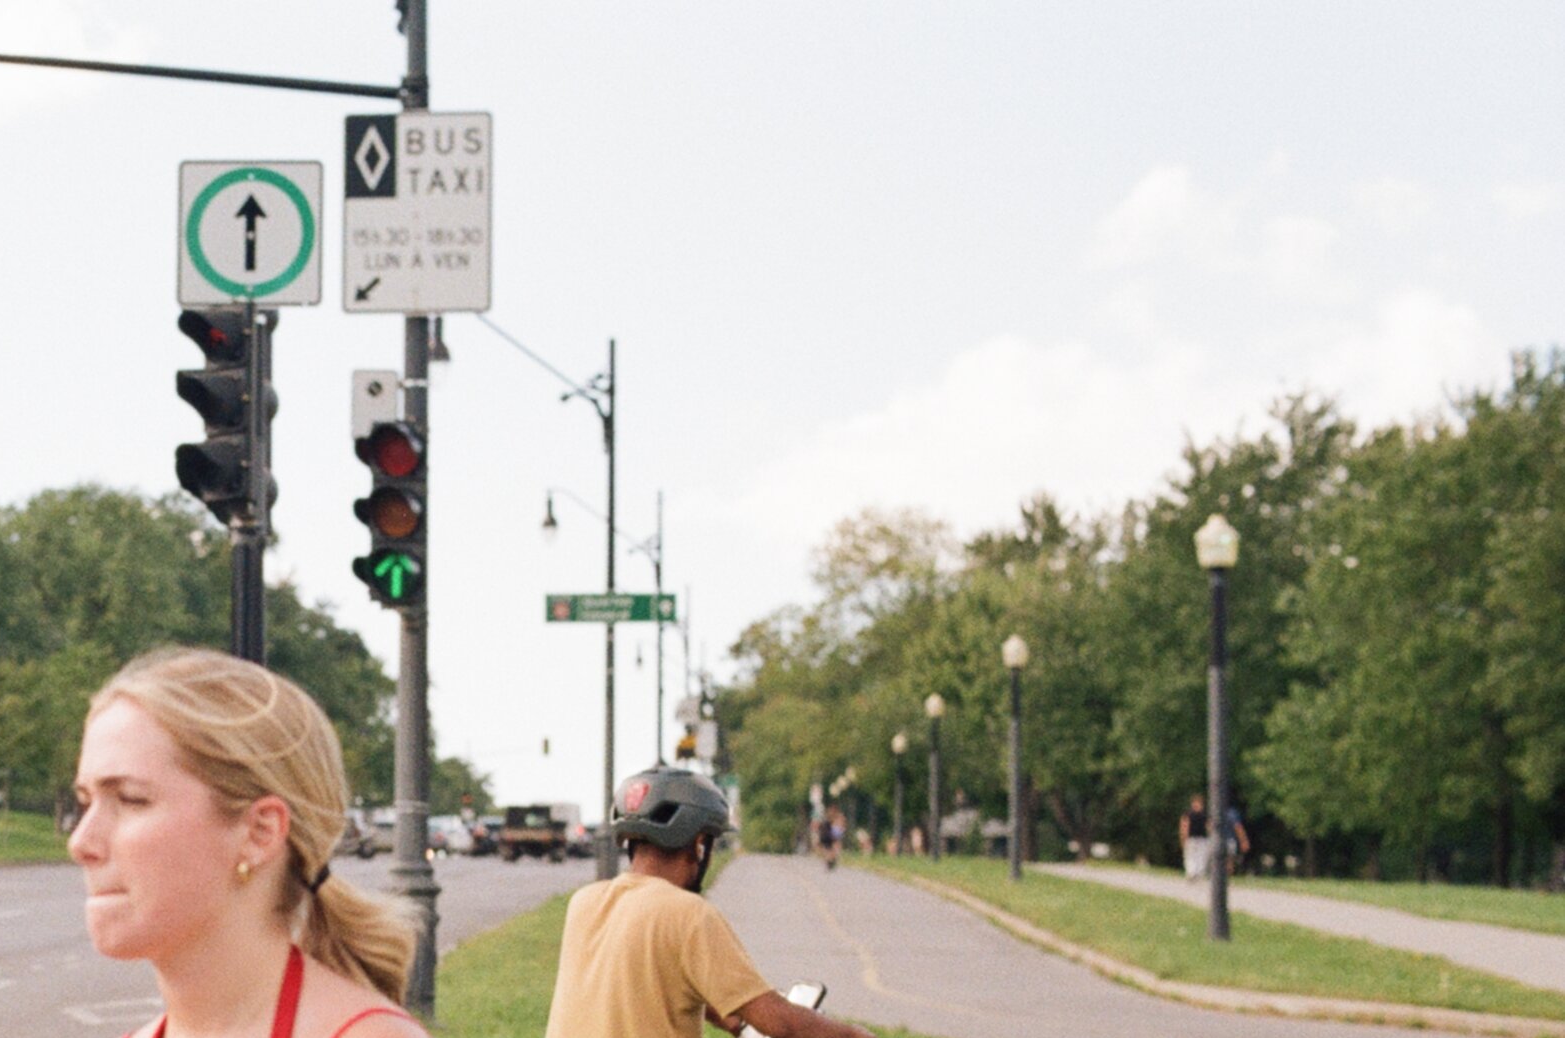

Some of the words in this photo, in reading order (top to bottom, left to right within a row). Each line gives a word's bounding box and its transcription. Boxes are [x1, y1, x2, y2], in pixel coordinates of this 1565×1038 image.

[405, 128, 482, 154] BUS
[408, 167, 483, 193] TAXI
[364, 252, 401, 270] LUN
[433, 252, 471, 269] VEN
